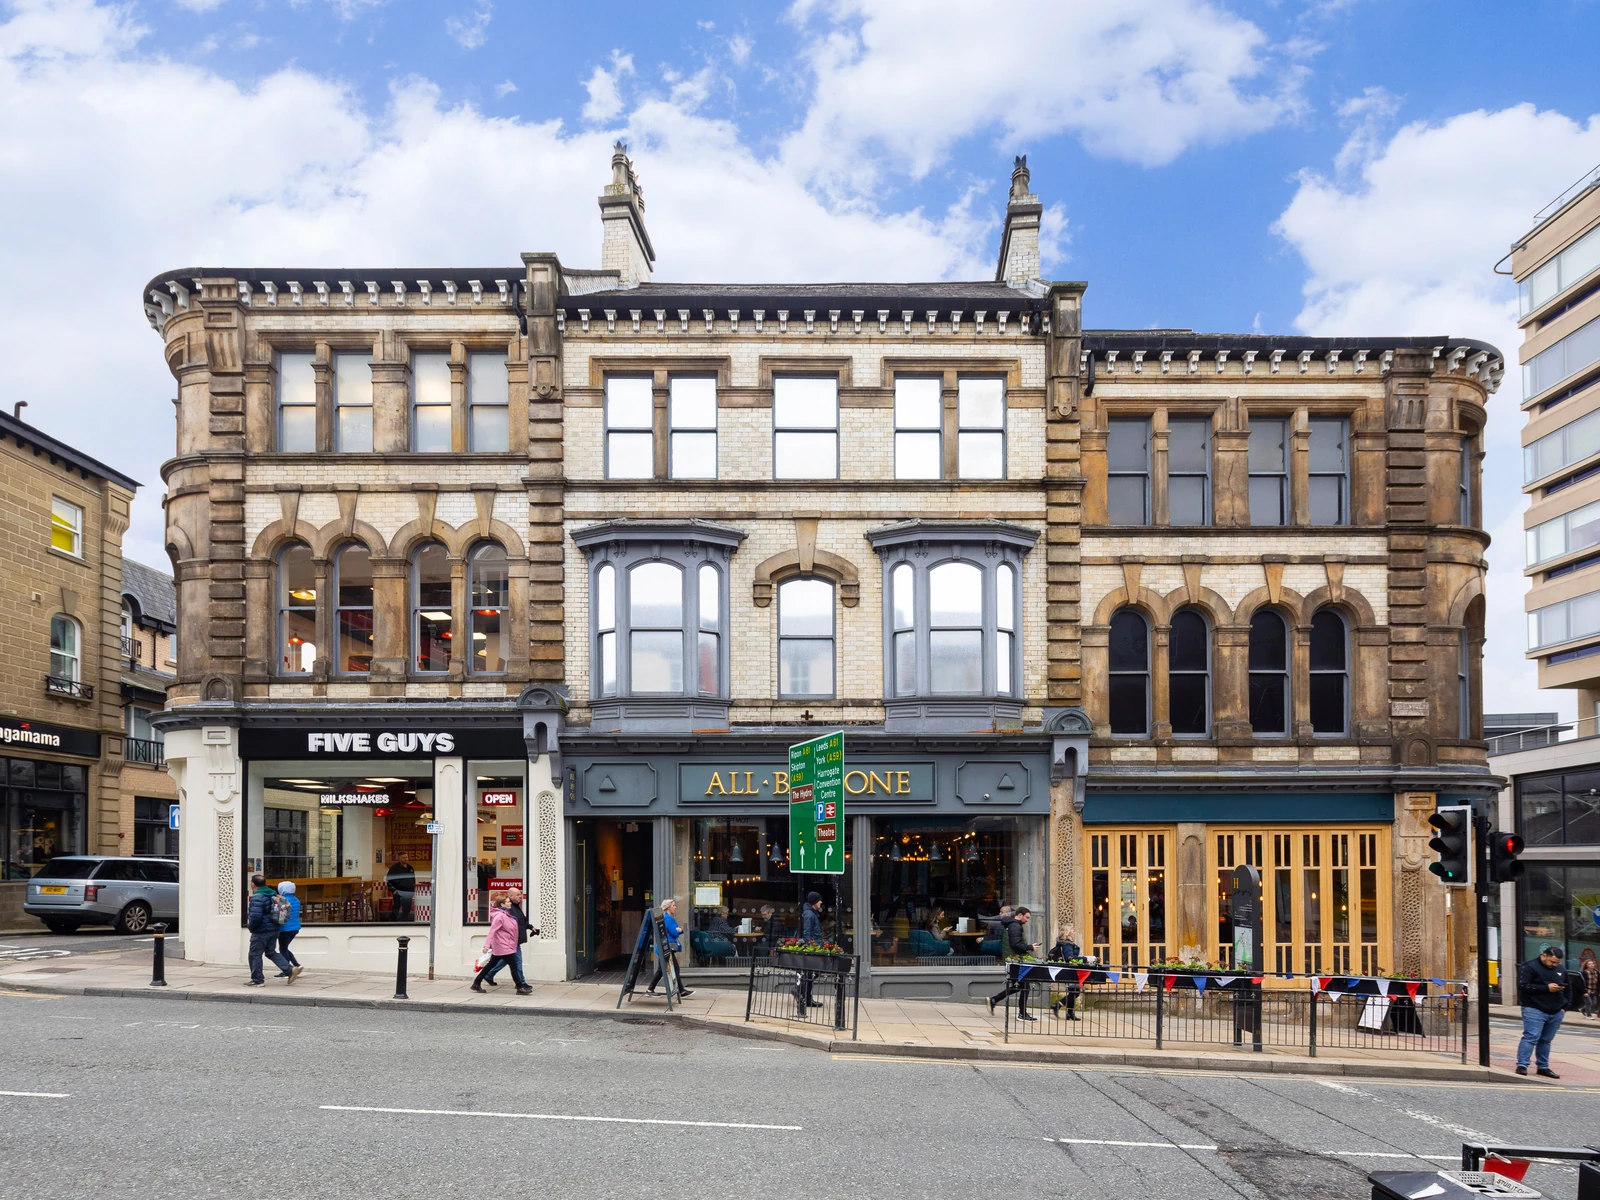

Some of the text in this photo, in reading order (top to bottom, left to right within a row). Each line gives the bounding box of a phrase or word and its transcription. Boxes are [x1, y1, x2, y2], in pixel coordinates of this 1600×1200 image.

[308, 732, 454, 752] FIVE GUYS
[816, 741, 829, 752] Leeds
[791, 750, 802, 759] Ripon
[816, 755, 826, 765] York
[791, 762, 806, 772] Skipton
[817, 766, 840, 778] Harrogate
[816, 778, 841, 789] Convention
[800, 788, 812, 799] Hydro
[821, 789, 836, 799] Centre
[320, 794, 389, 804] MILKSHAKES
[485, 794, 513, 804] OPEN
[818, 828, 835, 837] Theatre
[1233, 877, 1239, 888] H
[1496, 1179, 1511, 1189] STUB
